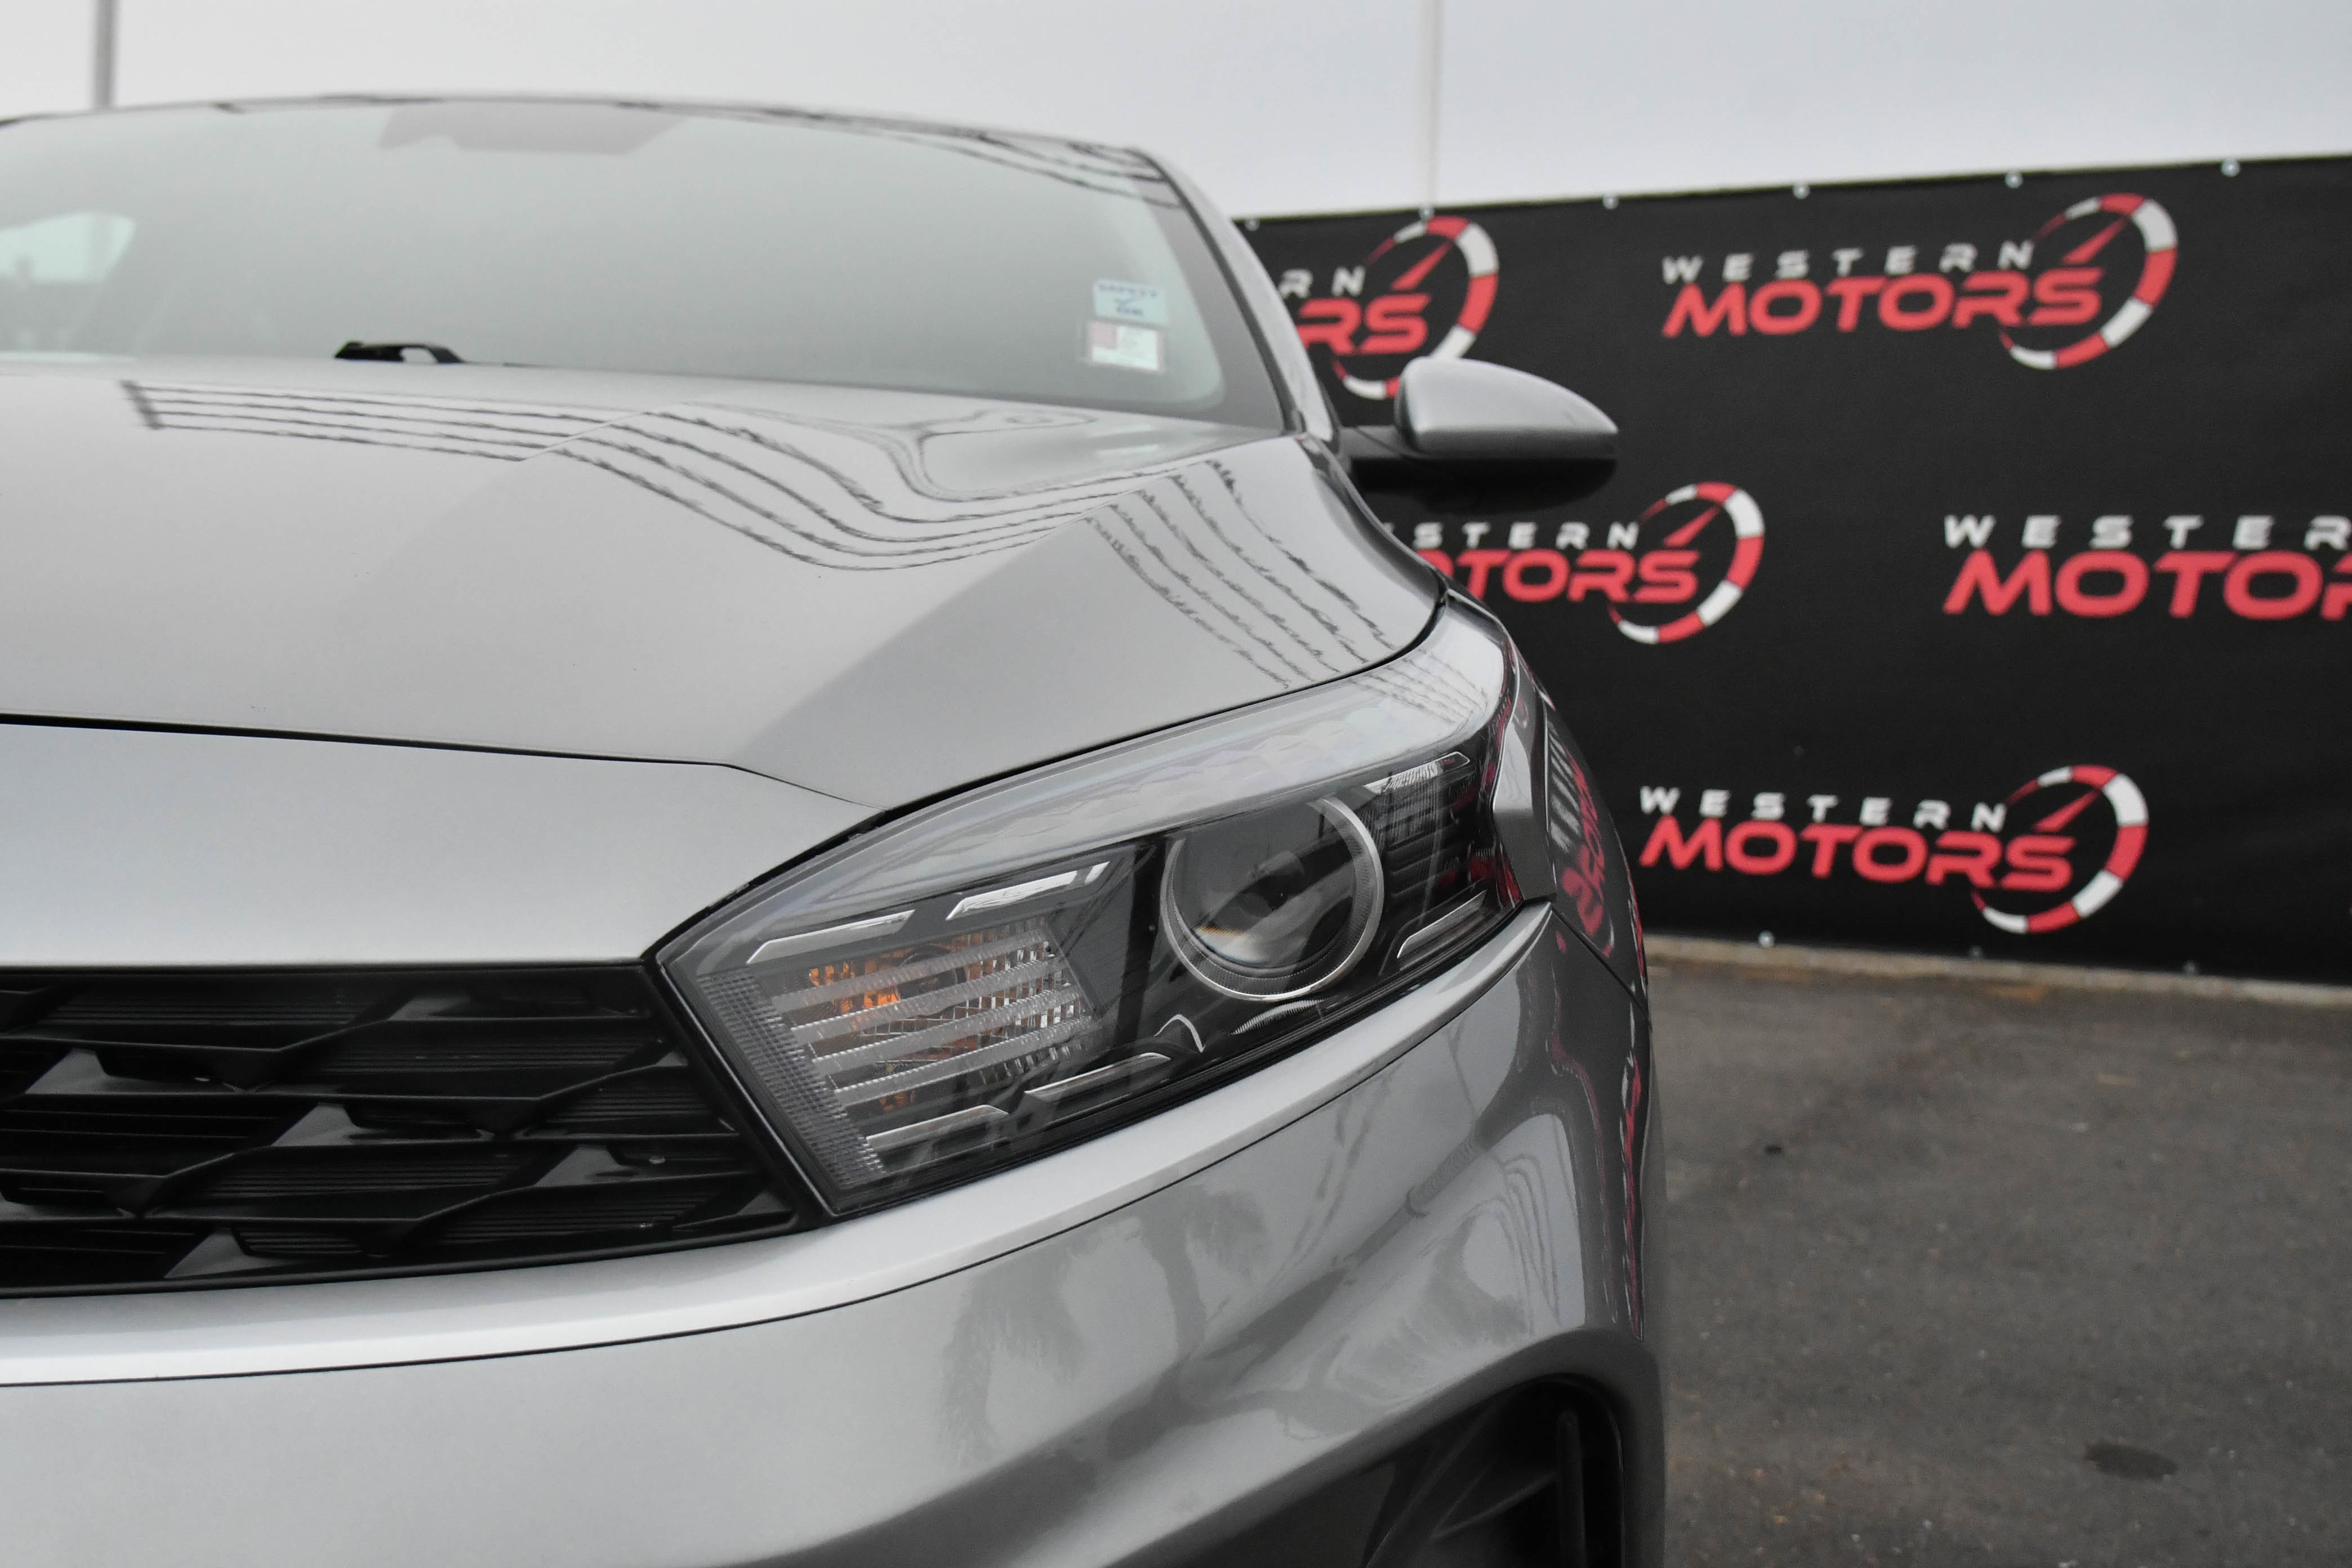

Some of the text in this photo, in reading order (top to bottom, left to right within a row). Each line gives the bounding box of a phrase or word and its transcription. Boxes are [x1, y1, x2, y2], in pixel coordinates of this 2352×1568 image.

[1662, 239, 2033, 284] WESTERN
[1663, 267, 2105, 337] MOTORS
[1382, 522, 1639, 550] STERN
[1640, 786, 2007, 832] WESTERN
[1639, 814, 2076, 892] MOTORS
